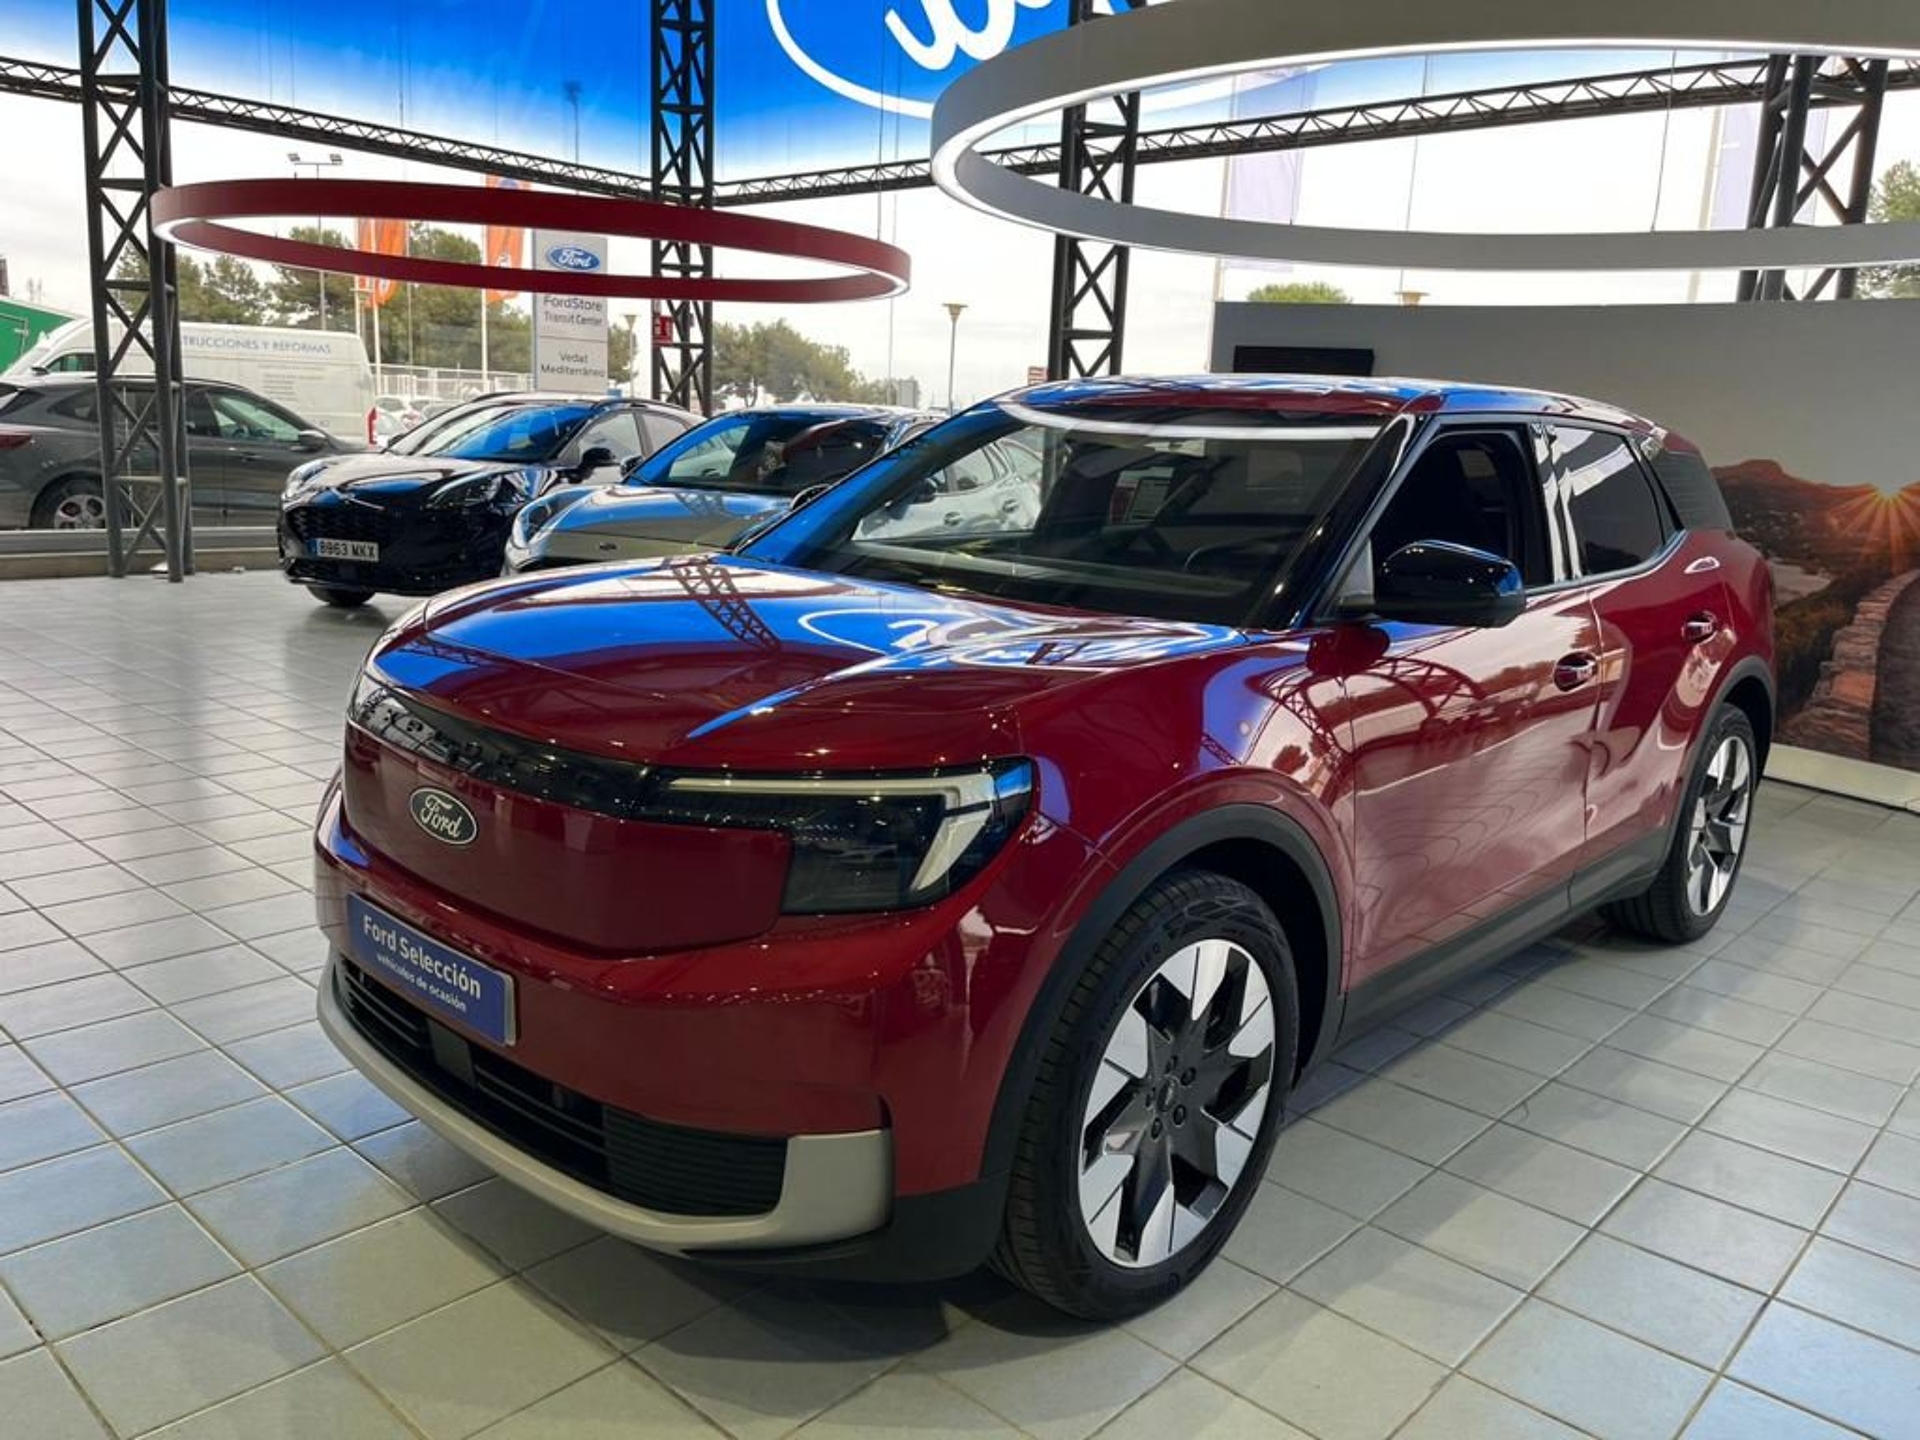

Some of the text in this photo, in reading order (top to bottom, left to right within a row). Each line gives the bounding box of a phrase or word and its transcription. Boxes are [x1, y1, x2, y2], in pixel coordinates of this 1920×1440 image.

[558, 251, 591, 267] Ford
[543, 296, 602, 312] FordStore
[182, 335, 259, 350] TRUCCIONES
[272, 341, 331, 354] REFORMAS
[559, 351, 589, 364] Vedat
[419, 793, 462, 838] Ford
[363, 914, 481, 1000] Ford Selección
[415, 976, 428, 991] de
